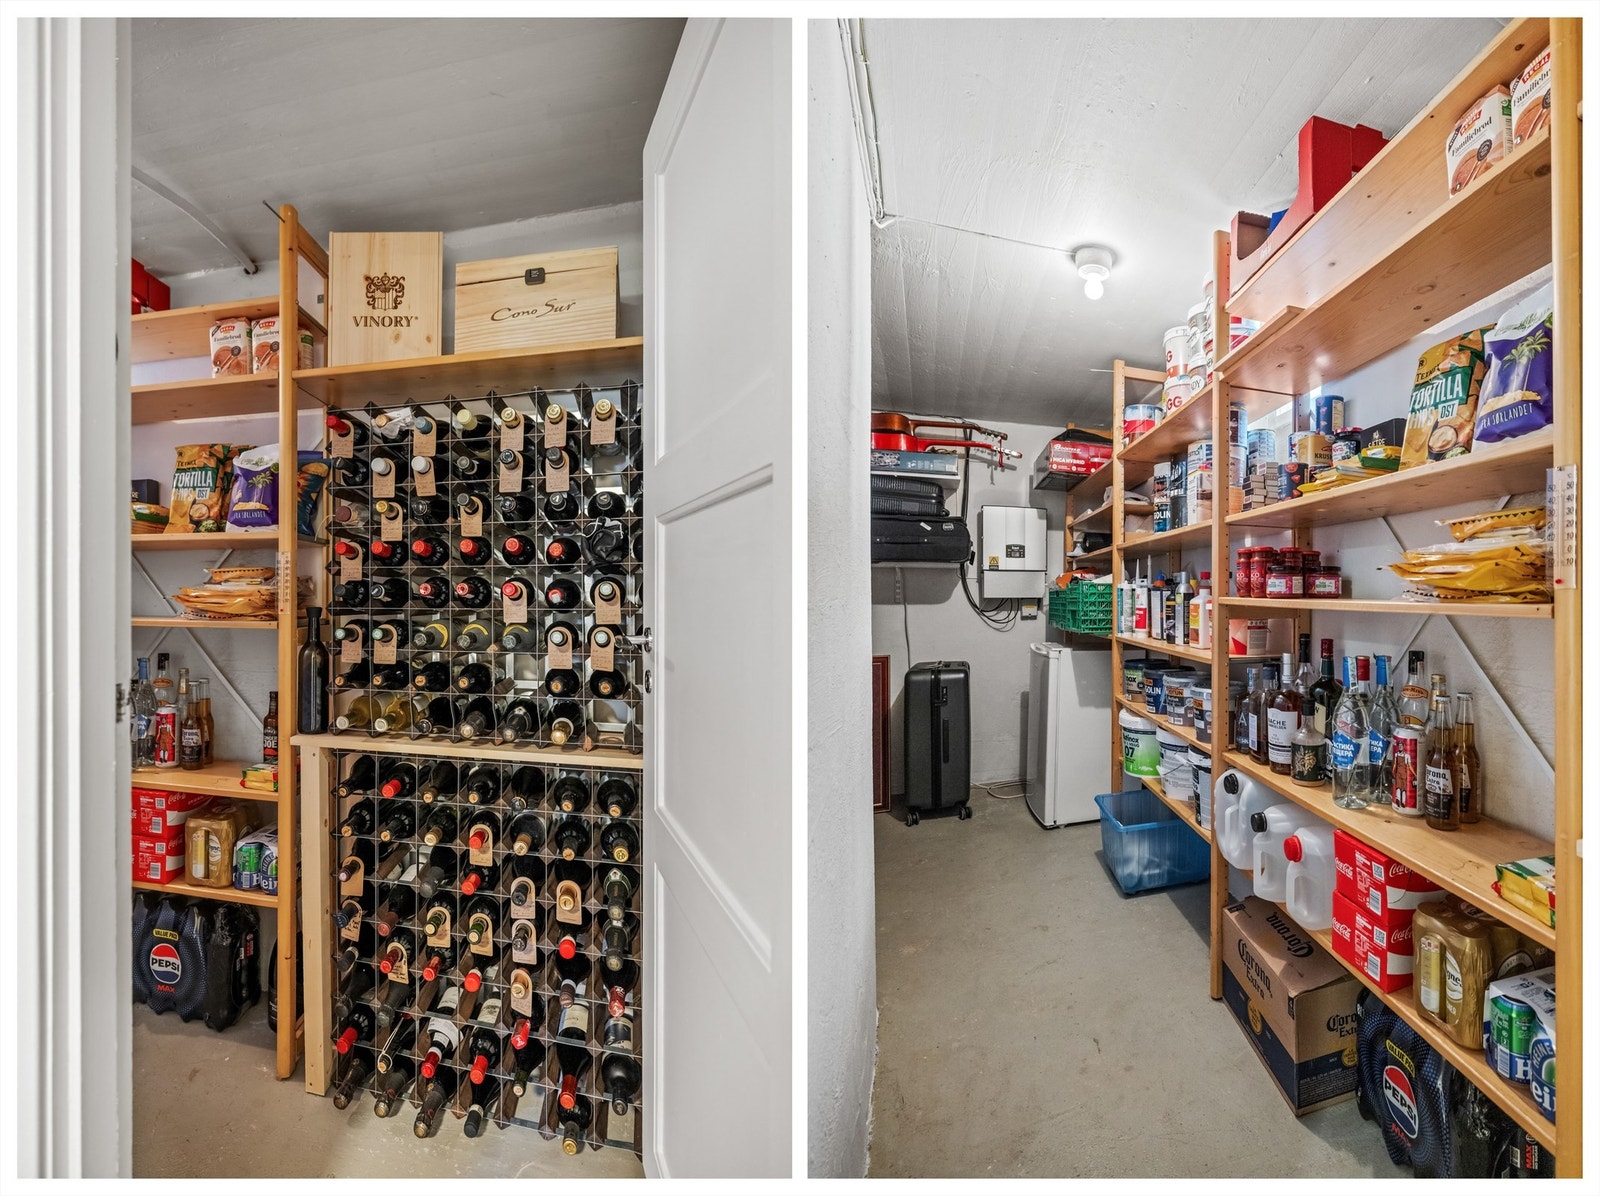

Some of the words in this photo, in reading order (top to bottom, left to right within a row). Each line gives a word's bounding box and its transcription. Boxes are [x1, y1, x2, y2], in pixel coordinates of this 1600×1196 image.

[1522, 52, 1551, 84] REGAL
[1513, 69, 1551, 107] Familiebr
[490, 306, 538, 322] Cono
[536, 298, 577, 318] Sur
[352, 315, 414, 328] VINORY
[1409, 373, 1463, 413] TORTILLA
[1440, 403, 1456, 418] OST
[174, 471, 212, 489] TORTILLA
[151, 957, 180, 972] PEPSI
[157, 984, 175, 993] MAX
[1326, 1013, 1357, 1032] Coro
[1384, 1079, 1417, 1127] PEPSI
